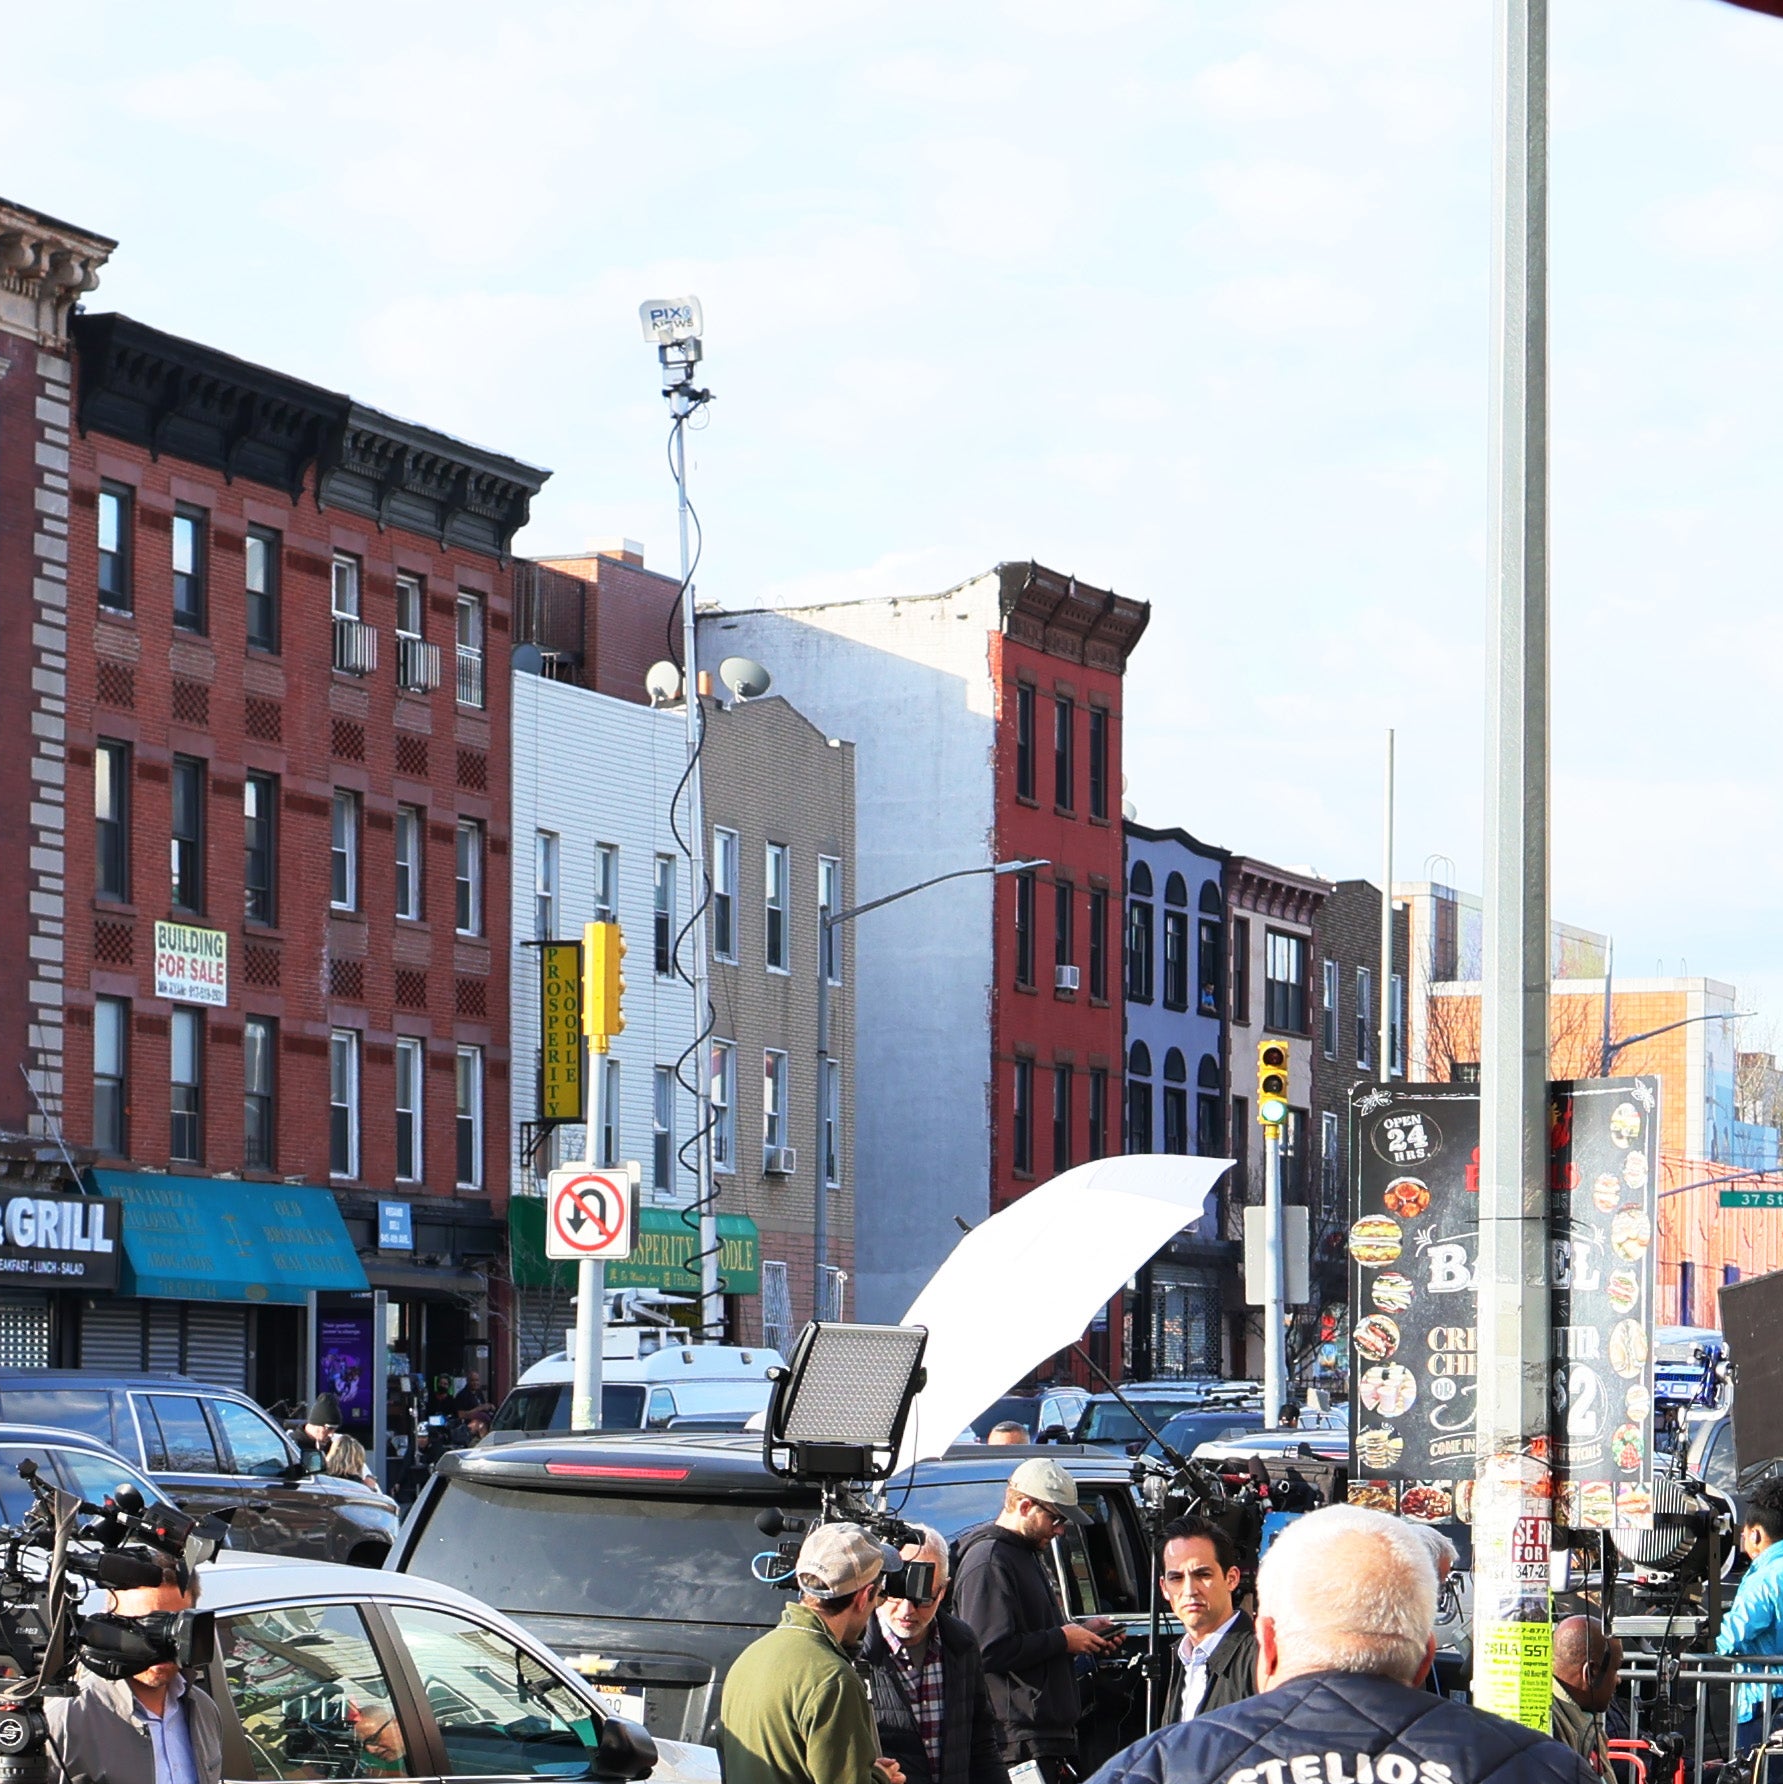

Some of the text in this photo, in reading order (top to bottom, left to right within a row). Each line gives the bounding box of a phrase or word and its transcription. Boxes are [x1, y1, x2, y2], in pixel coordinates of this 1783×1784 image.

[158, 925, 223, 958] BUILDING
[157, 953, 224, 985] FOR SALE
[546, 948, 561, 1117] PROSPERITY
[563, 979, 577, 1083] NOODLE
[1383, 1114, 1422, 1129] OPEN
[1387, 1125, 1429, 1152] 24
[1394, 1149, 1432, 1162] HRS.
[1741, 1193, 1783, 1205] 37 St
[5, 1197, 113, 1253] GRILL
[34, 1260, 57, 1274] LUNCH
[61, 1261, 85, 1276] SALAD
[1429, 1438, 1462, 1457] COME
[1515, 1546, 1543, 1560] FOR
[1524, 1645, 1550, 1657] SST
